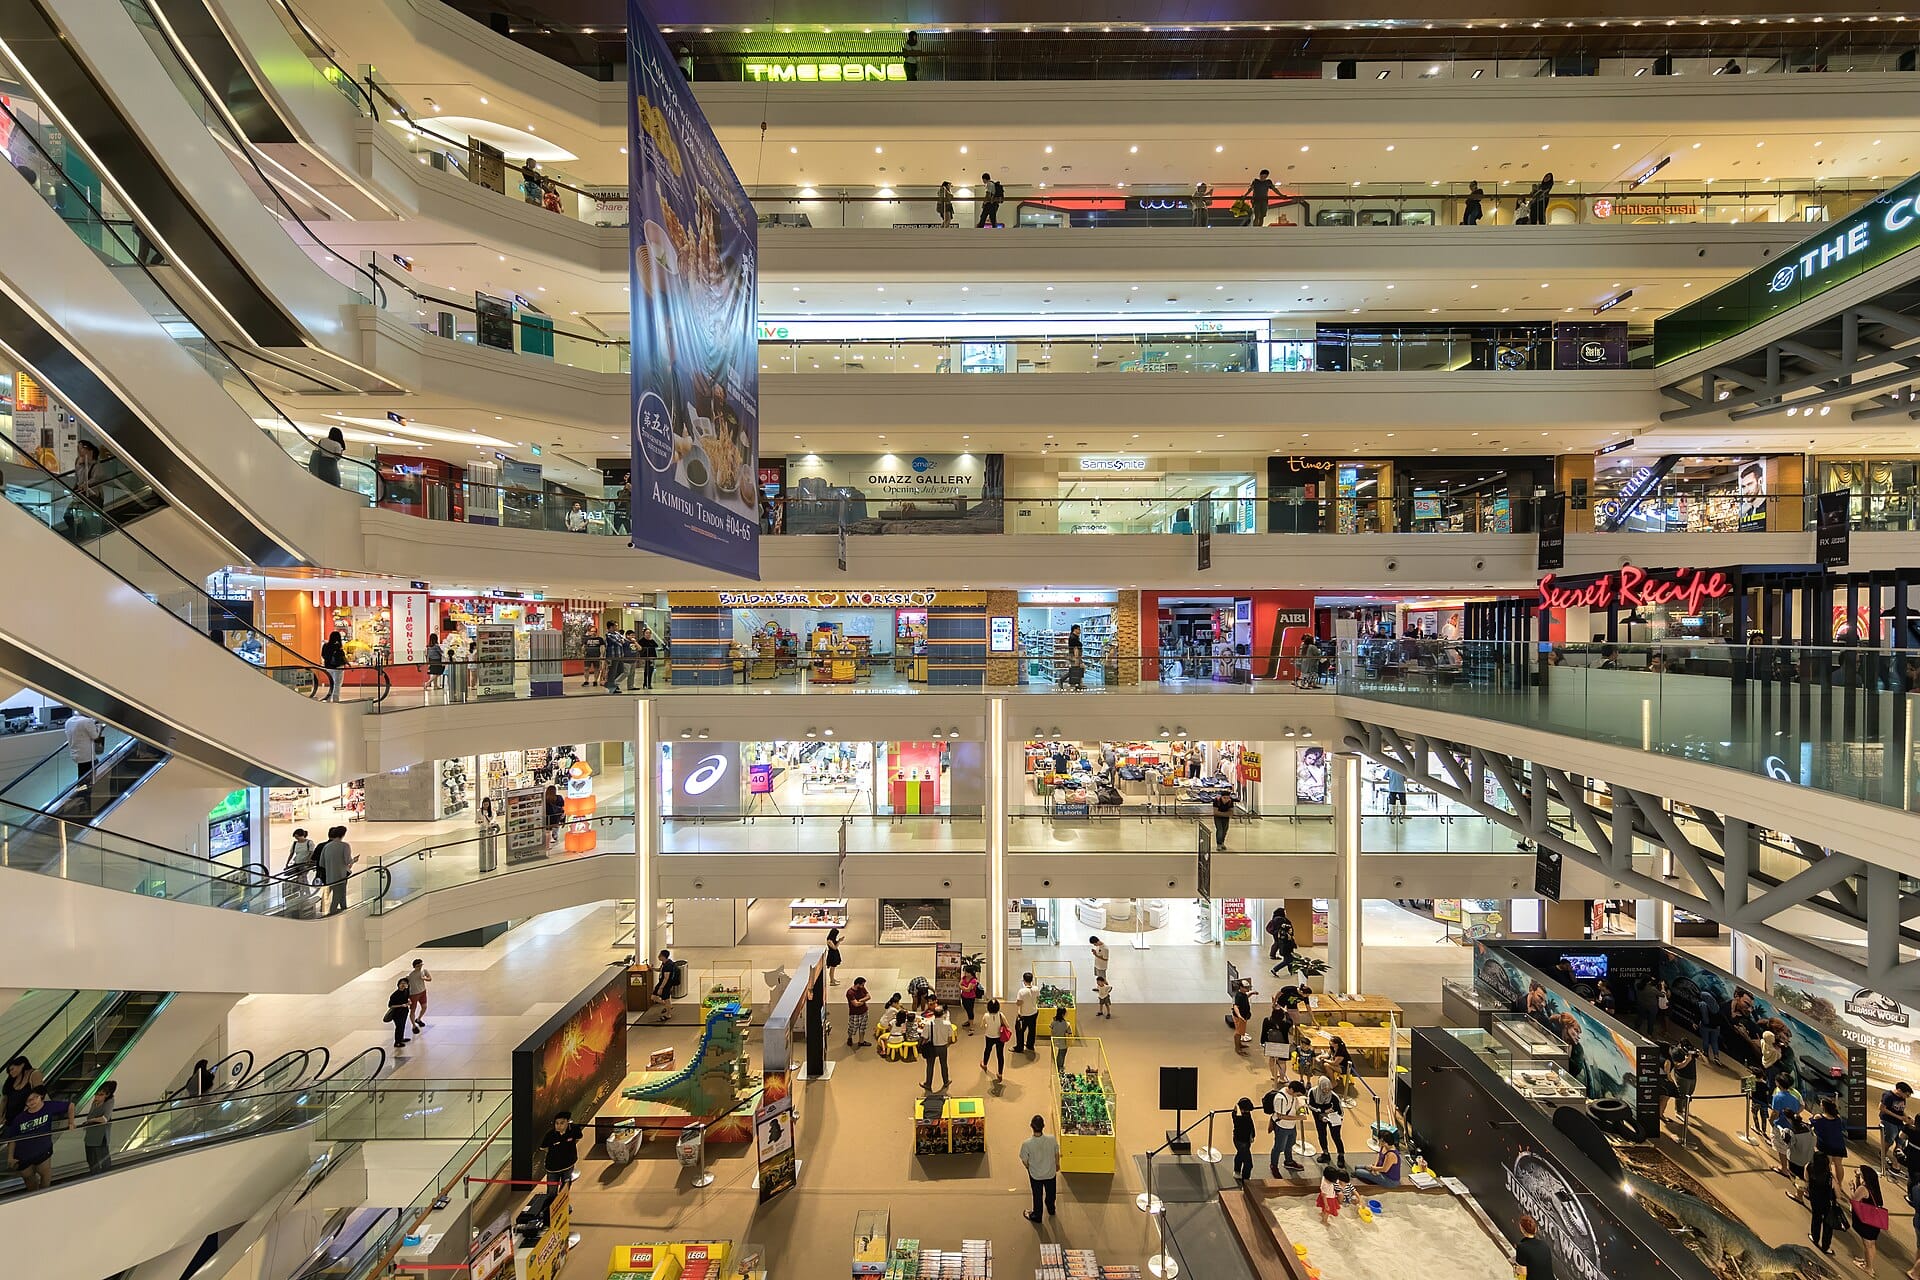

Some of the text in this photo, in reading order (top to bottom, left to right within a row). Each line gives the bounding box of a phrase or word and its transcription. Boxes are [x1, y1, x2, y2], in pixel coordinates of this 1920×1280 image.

[746, 64, 907, 81] TIMEZONE
[596, 202, 623, 211] Share
[1615, 205, 1697, 214] ichiban sushi
[1800, 190, 1920, 277] THE C
[1082, 460, 1145, 470] Samsonite
[1287, 456, 1334, 472] times
[868, 475, 972, 484] OMAZZ GALLERY
[883, 486, 920, 495] Opening
[921, 486, 937, 495] July
[1416, 501, 1429, 510] 25
[653, 481, 694, 517] AKIMITSU
[696, 502, 725, 531] TENDON
[726, 515, 751, 541] #04-65
[1539, 566, 1733, 616] Secret Recipe
[1280, 613, 1306, 623] AIBI
[752, 775, 765, 783] 40
[1877, 1009, 1906, 1024] WORLD
[1878, 1037, 1886, 1048] &
[1888, 1042, 1911, 1056] ROAR
[1505, 1170, 1557, 1240] JURASSIC
[632, 1254, 651, 1262] LEGO
[687, 1252, 706, 1260] LEGO
